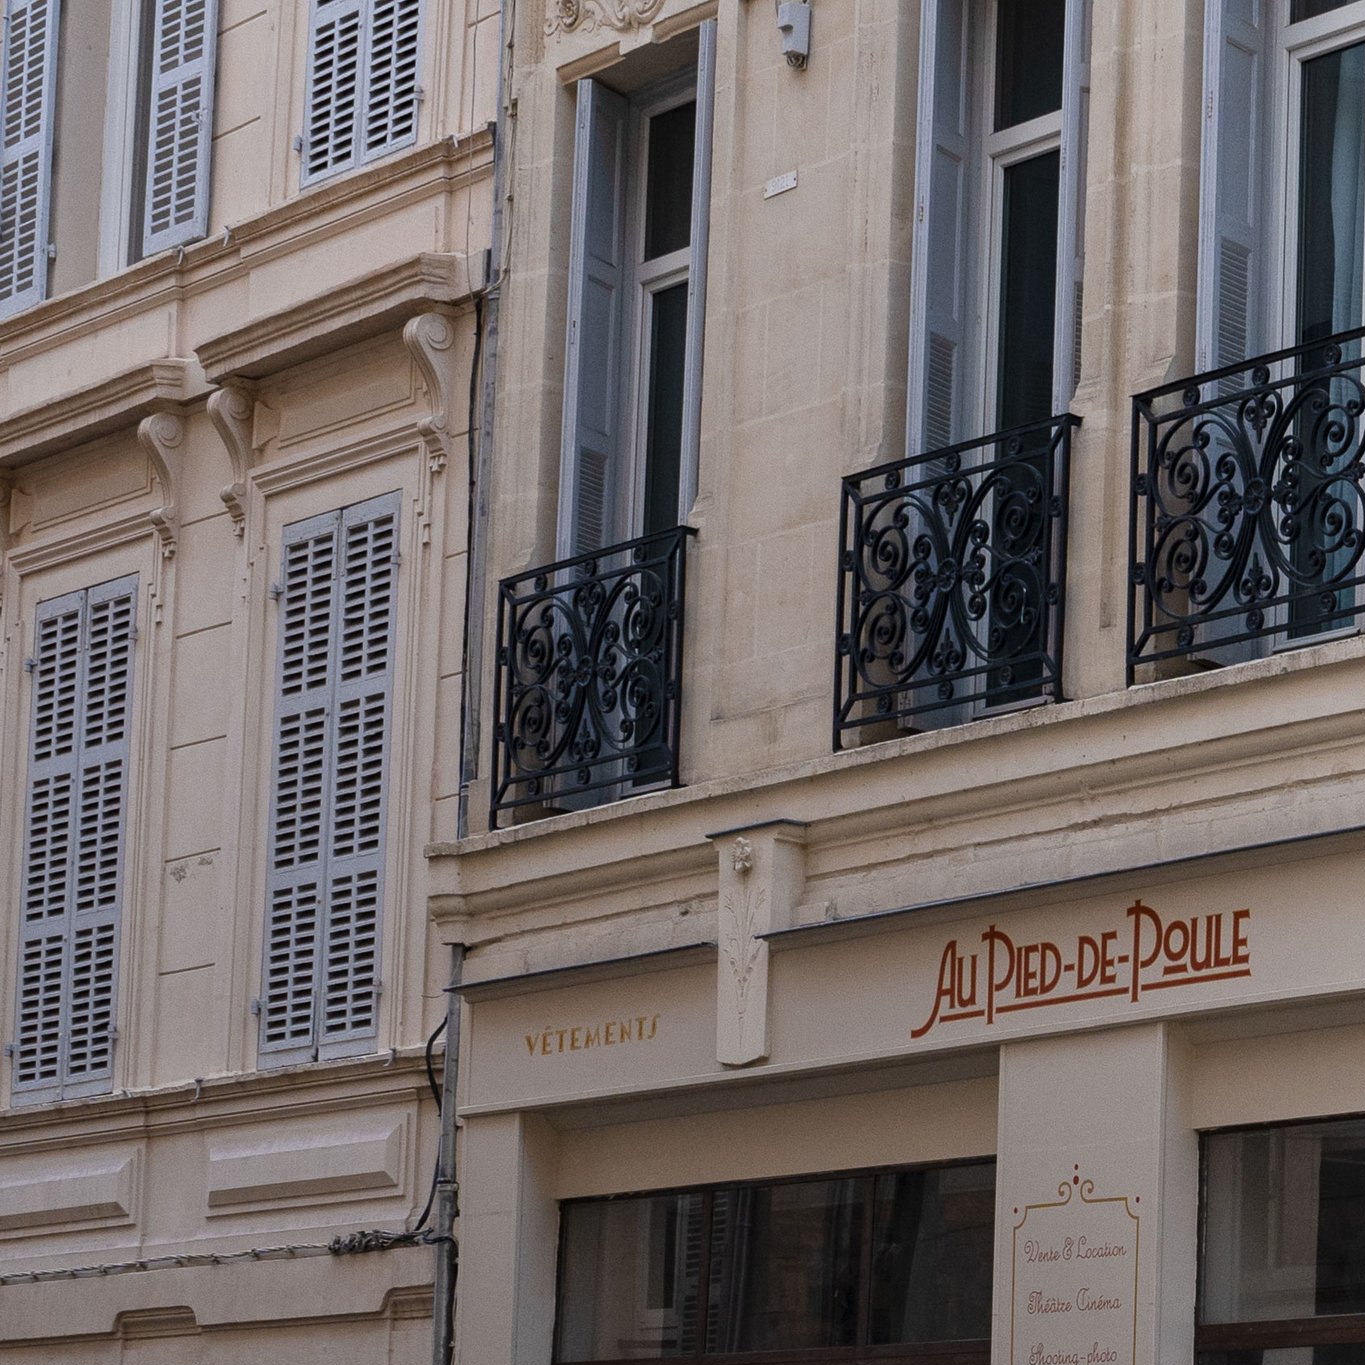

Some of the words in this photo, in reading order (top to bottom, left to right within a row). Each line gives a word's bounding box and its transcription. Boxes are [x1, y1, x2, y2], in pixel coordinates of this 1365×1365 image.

[1024, 1240, 1061, 1264] Vente
[1075, 1235, 1127, 1259] Location
[1076, 1287, 1122, 1311] Cinéma
